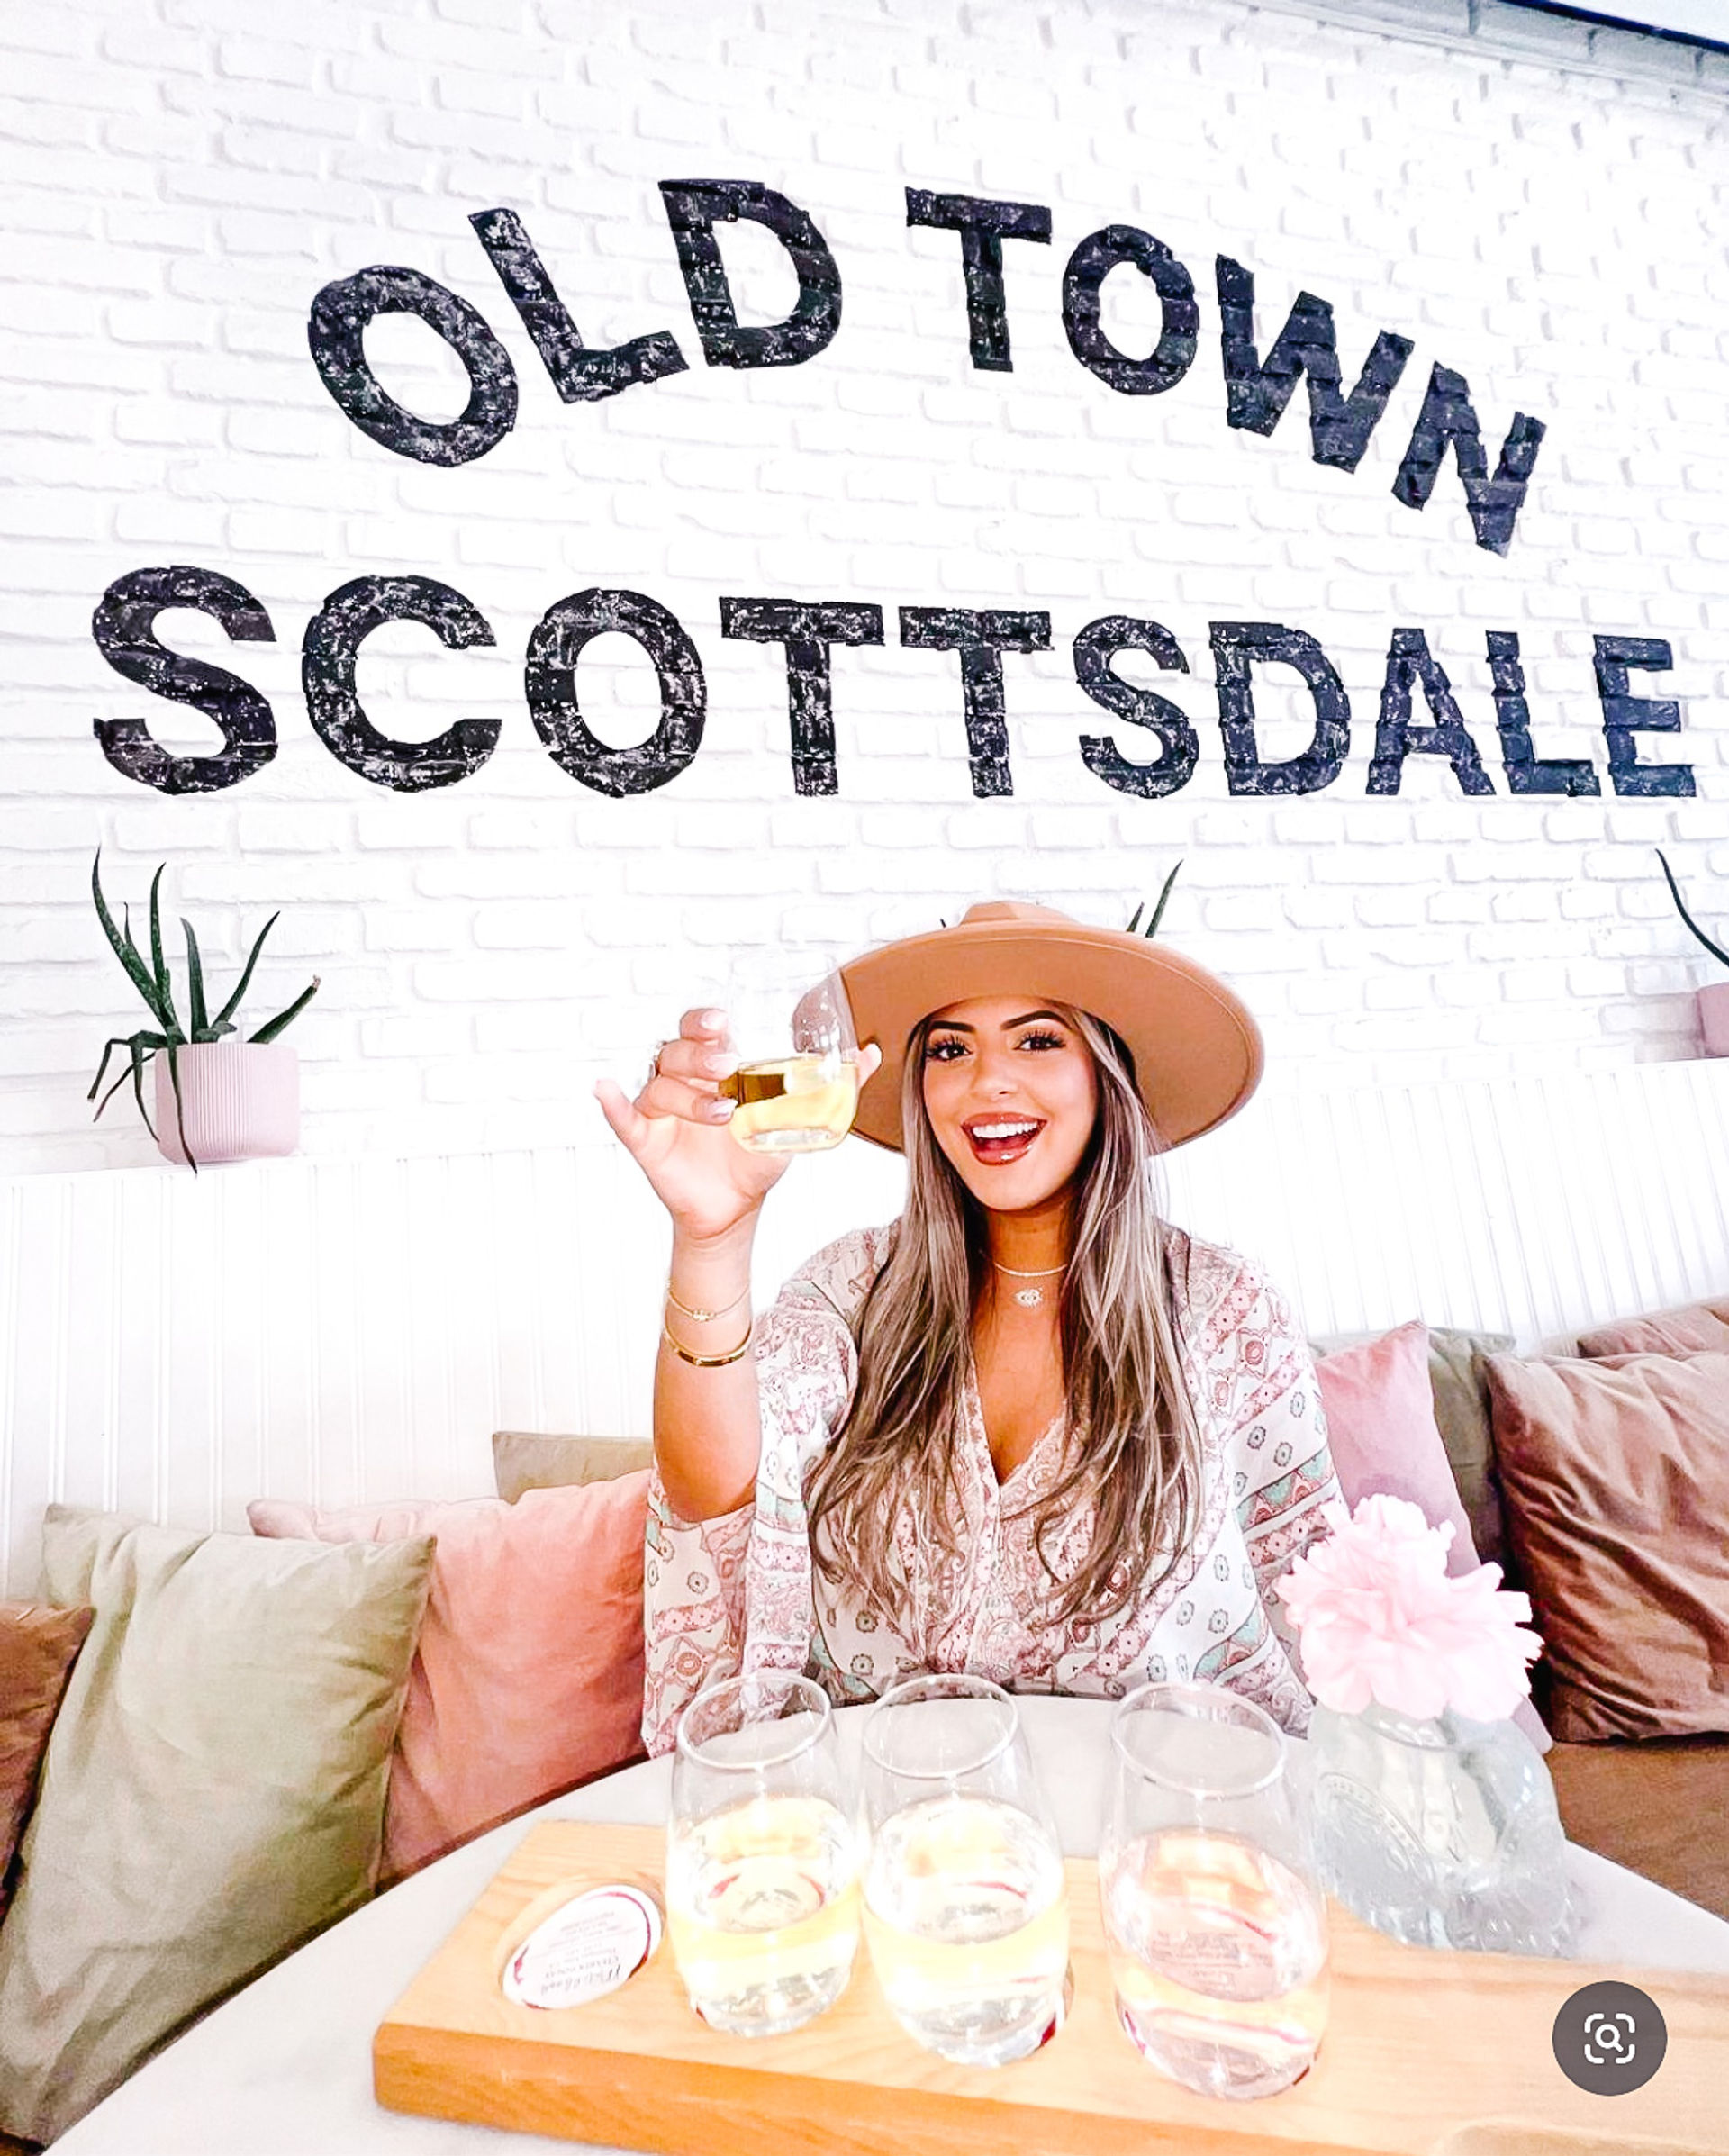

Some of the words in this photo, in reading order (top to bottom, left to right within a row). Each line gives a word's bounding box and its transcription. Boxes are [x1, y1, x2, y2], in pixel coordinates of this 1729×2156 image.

[308, 179, 842, 468] OLD
[905, 186, 1546, 555] TOWN
[92, 566, 1698, 799] SCOTTSDALE
